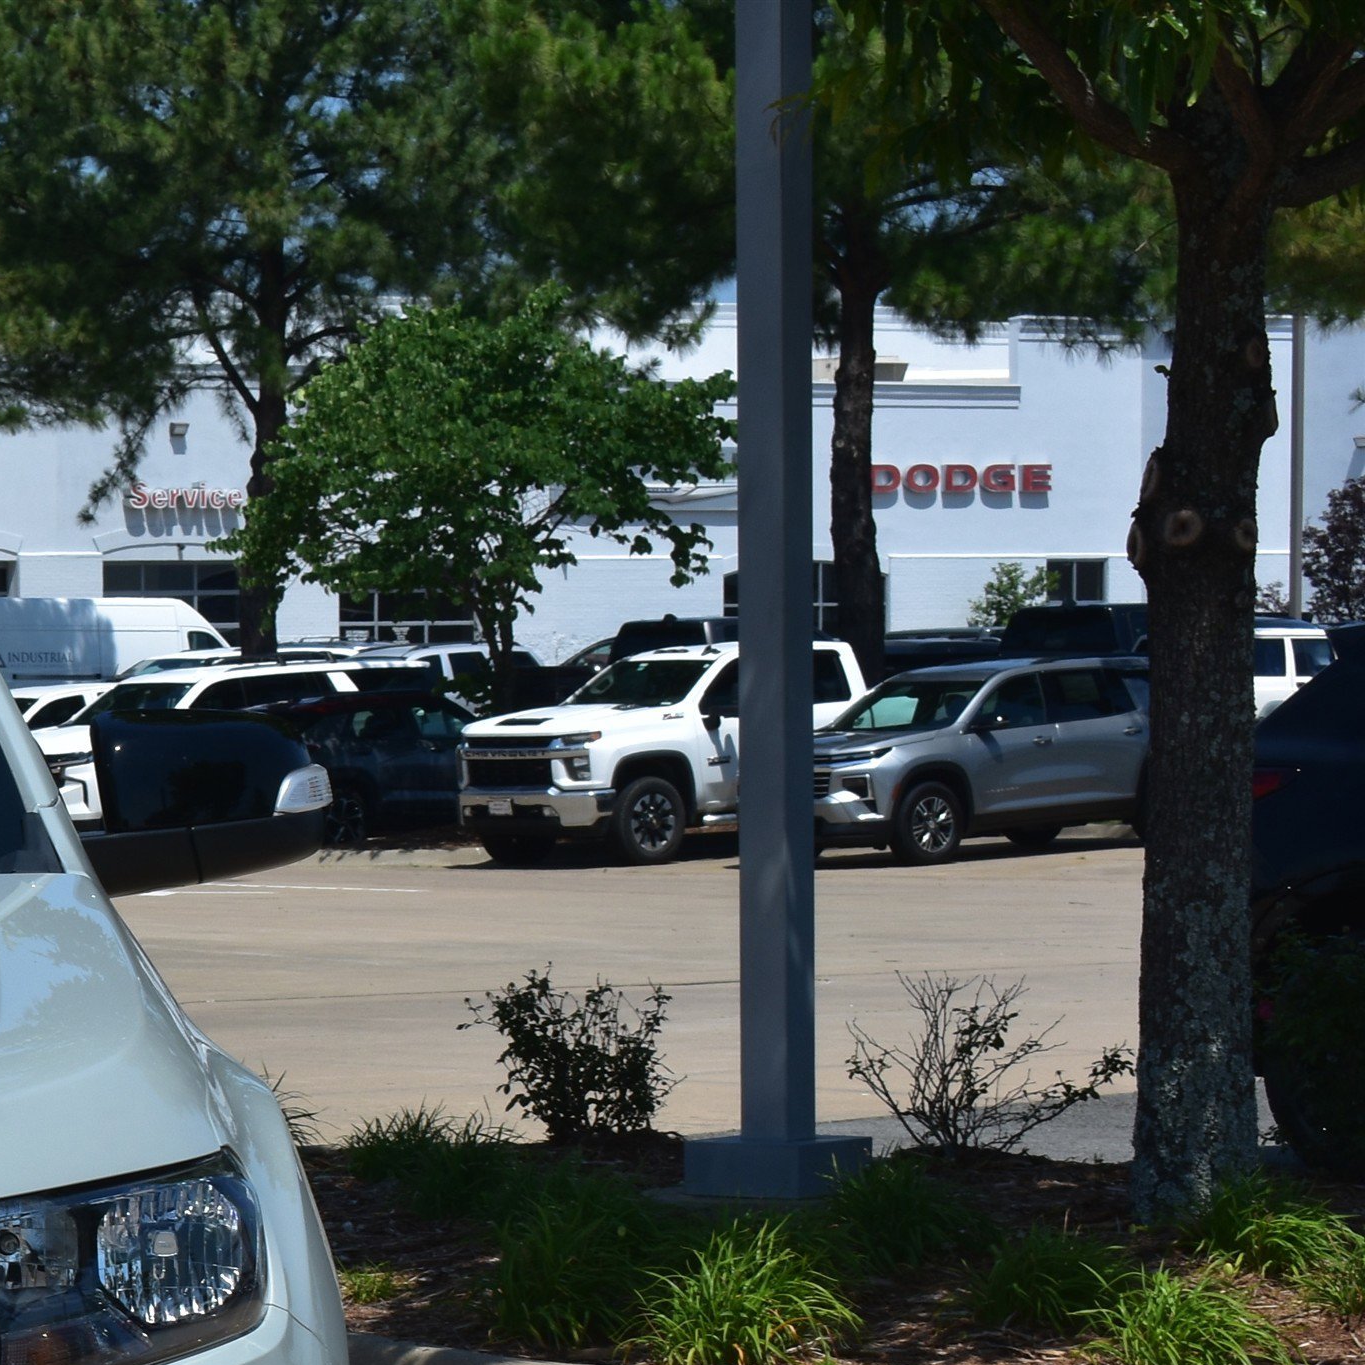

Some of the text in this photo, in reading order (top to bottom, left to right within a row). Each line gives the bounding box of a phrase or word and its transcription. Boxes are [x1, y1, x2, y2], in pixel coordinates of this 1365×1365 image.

[871, 463, 1052, 493] DODGE
[128, 481, 244, 509] Service
[7, 651, 76, 664] INDUSTRIAL
